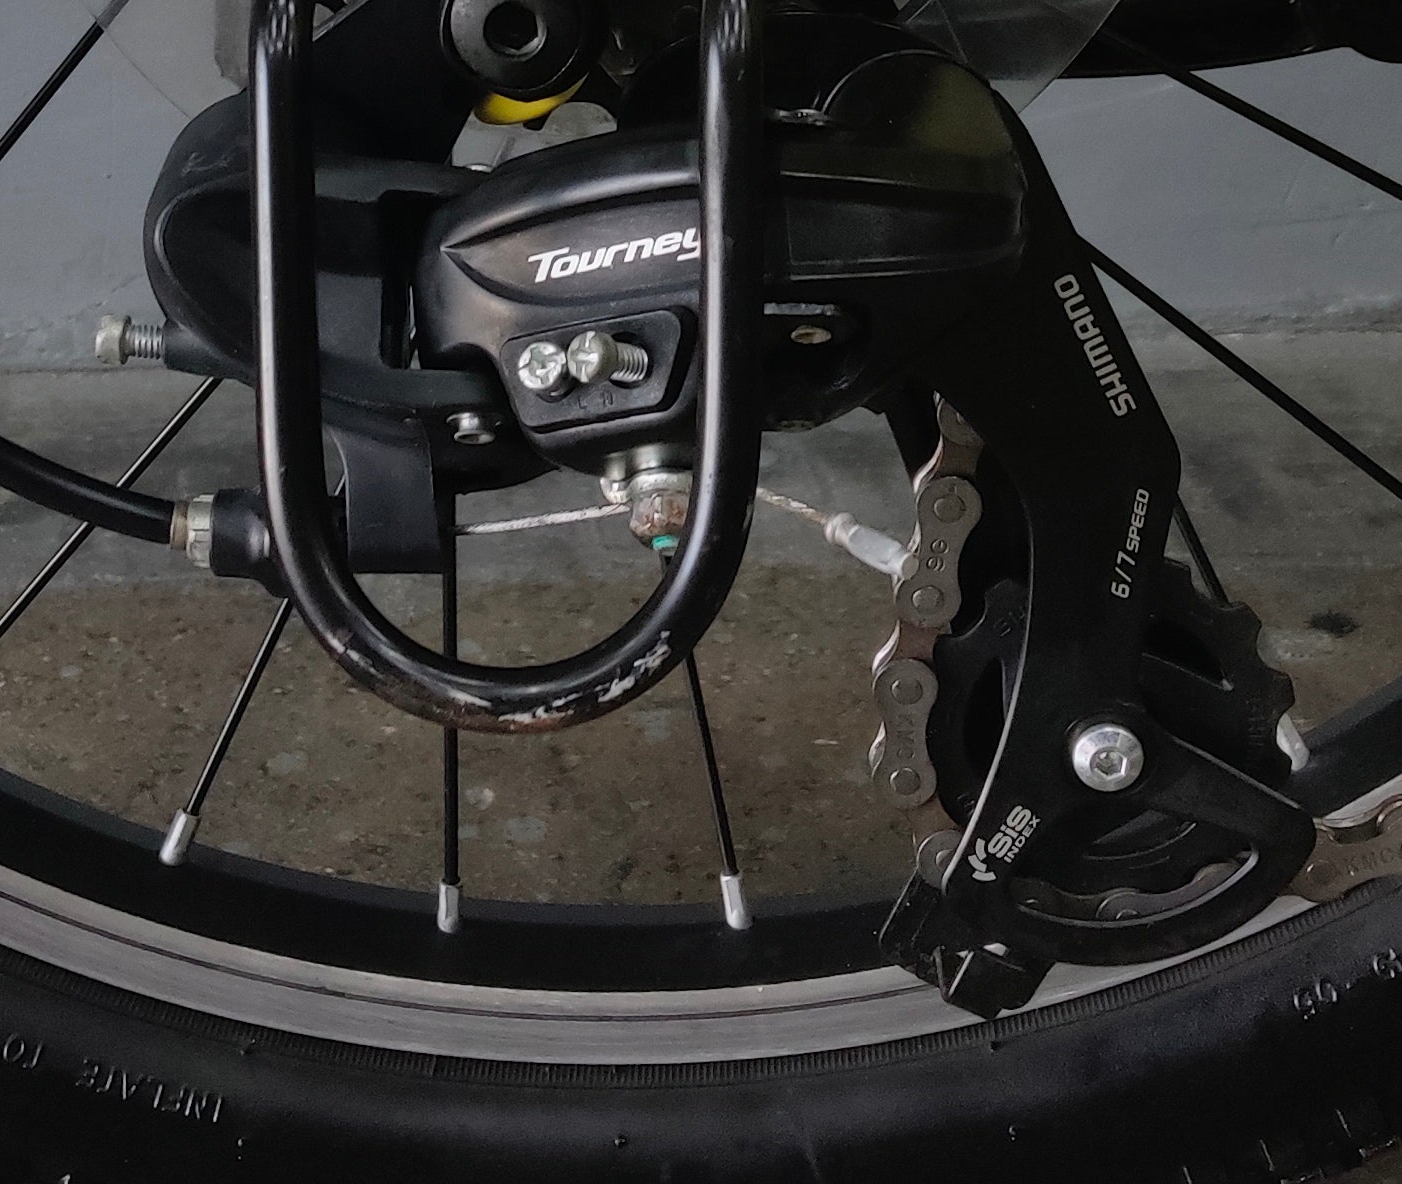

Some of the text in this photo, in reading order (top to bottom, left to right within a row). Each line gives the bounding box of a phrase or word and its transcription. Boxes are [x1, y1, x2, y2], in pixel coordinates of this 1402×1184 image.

[528, 226, 701, 284] Tourney
[1051, 273, 1139, 419] SHIMANO
[1003, 814, 1042, 864] INDEX
[1344, 846, 1395, 877] KMC
[2, 1031, 44, 1070] TO
[75, 1057, 226, 1124] INFLATE
